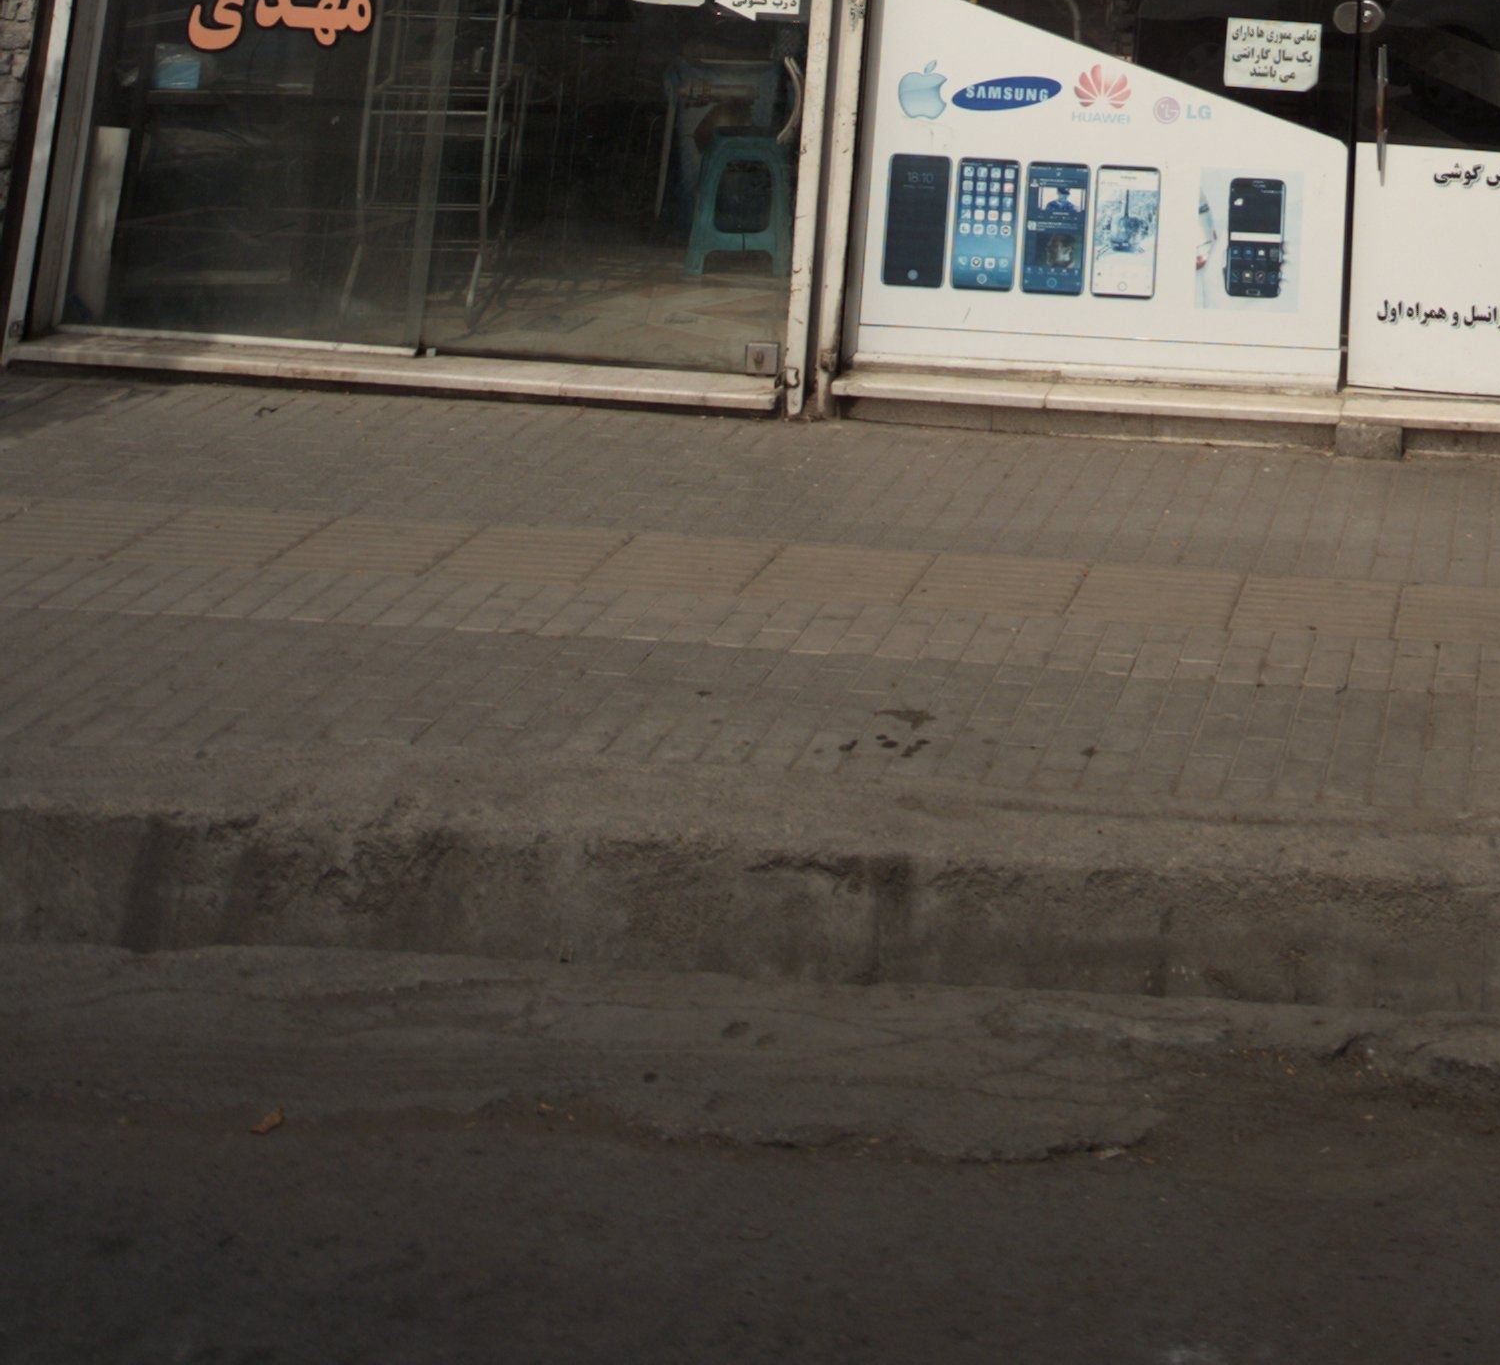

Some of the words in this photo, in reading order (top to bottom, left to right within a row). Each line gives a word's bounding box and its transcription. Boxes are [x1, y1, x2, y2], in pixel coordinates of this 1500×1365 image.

[772, 0, 797, 10] درب
[1231, 25, 1255, 42] دارای
[1256, 26, 1264, 38] ها
[1266, 31, 1292, 44] مموری
[1293, 29, 1317, 45] تمامی
[1232, 47, 1271, 64] گارانتی
[1273, 49, 1293, 65] سال
[1296, 50, 1313, 67] یک
[1250, 66, 1277, 82] باشند
[1279, 72, 1296, 83] می
[965, 85, 1050, 102] SAMSUNG
[1071, 112, 1131, 126] HUAWEI
[1186, 104, 1212, 120] LG
[1433, 163, 1482, 187] گوشی
[1377, 300, 1403, 321] اول
[1406, 302, 1448, 325] همراه
[1451, 312, 1460, 327] و
